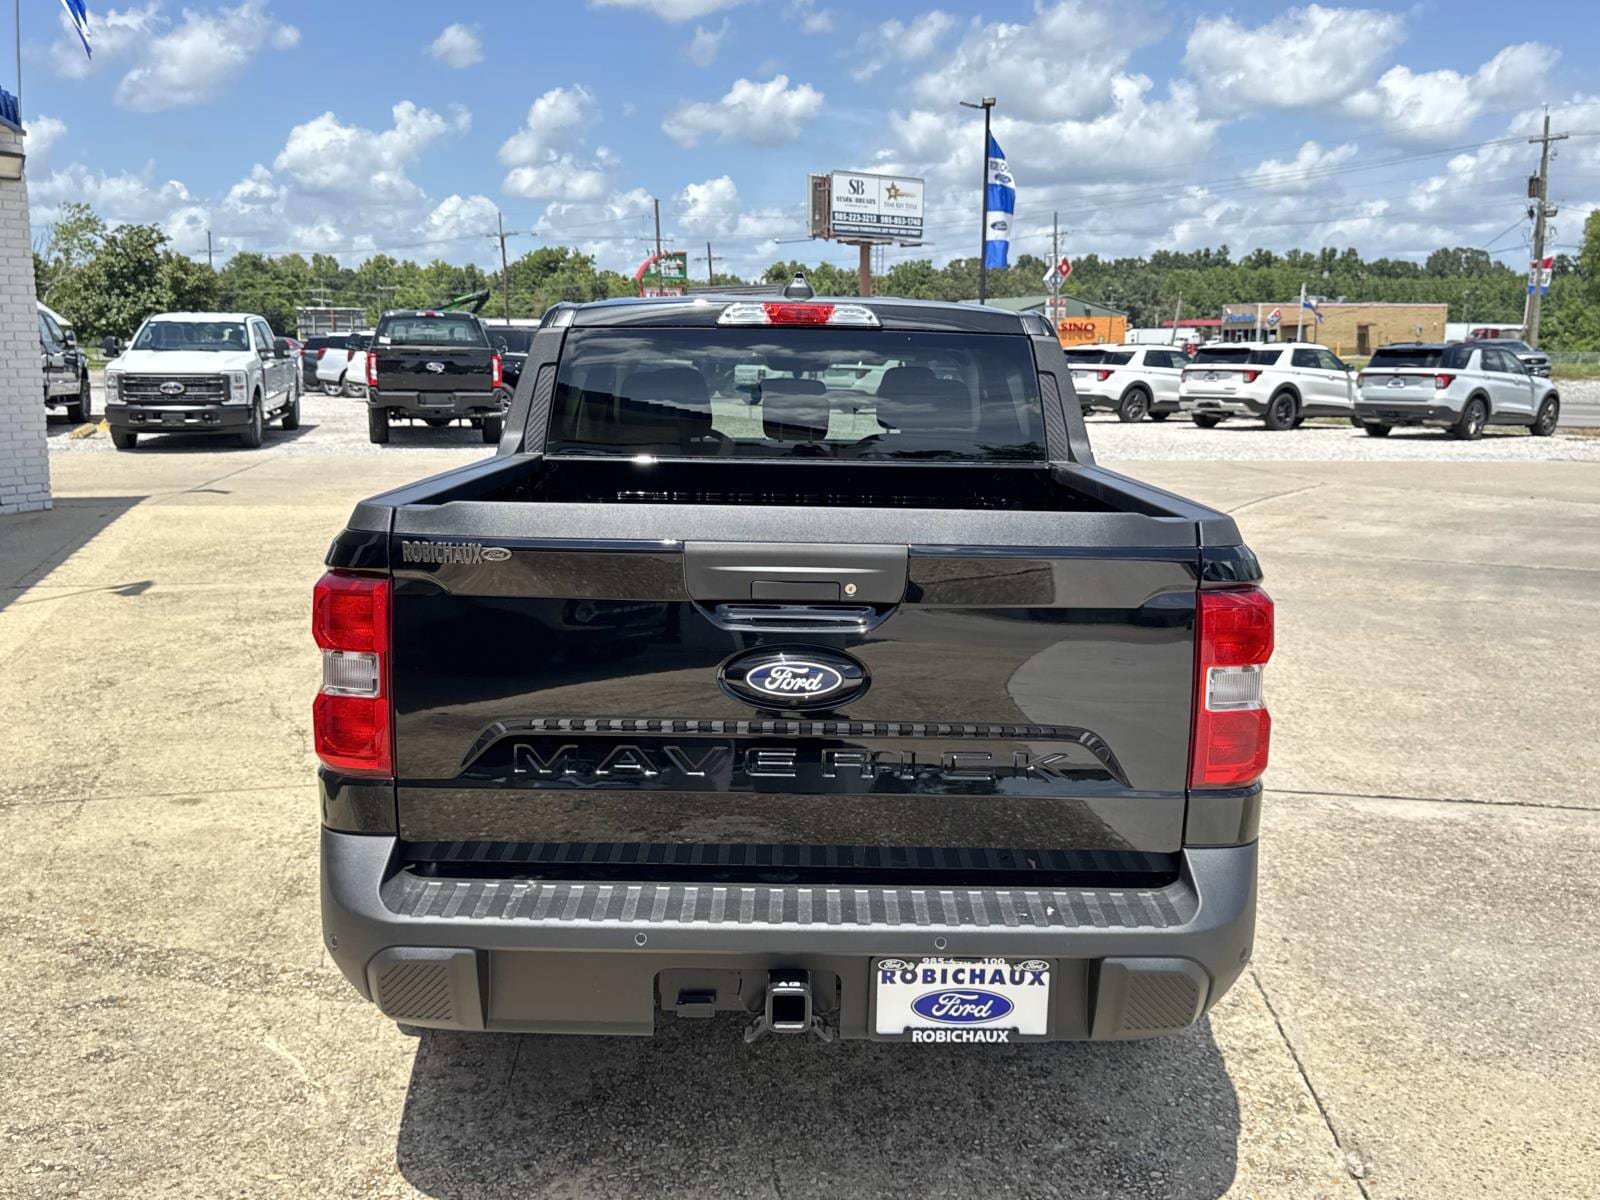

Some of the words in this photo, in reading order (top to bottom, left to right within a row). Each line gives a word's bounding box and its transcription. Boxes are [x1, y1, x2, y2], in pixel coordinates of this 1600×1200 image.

[848, 179, 865, 195] SB
[1058, 322, 1096, 332] SINO
[402, 540, 482, 565] ROBICHAUX
[765, 666, 824, 690] Ford
[513, 744, 1068, 780] MAVERICK
[881, 968, 1046, 986] ROBICHAUX
[931, 993, 993, 1017] Ford
[912, 1030, 1009, 1043] ROBICHAUX
